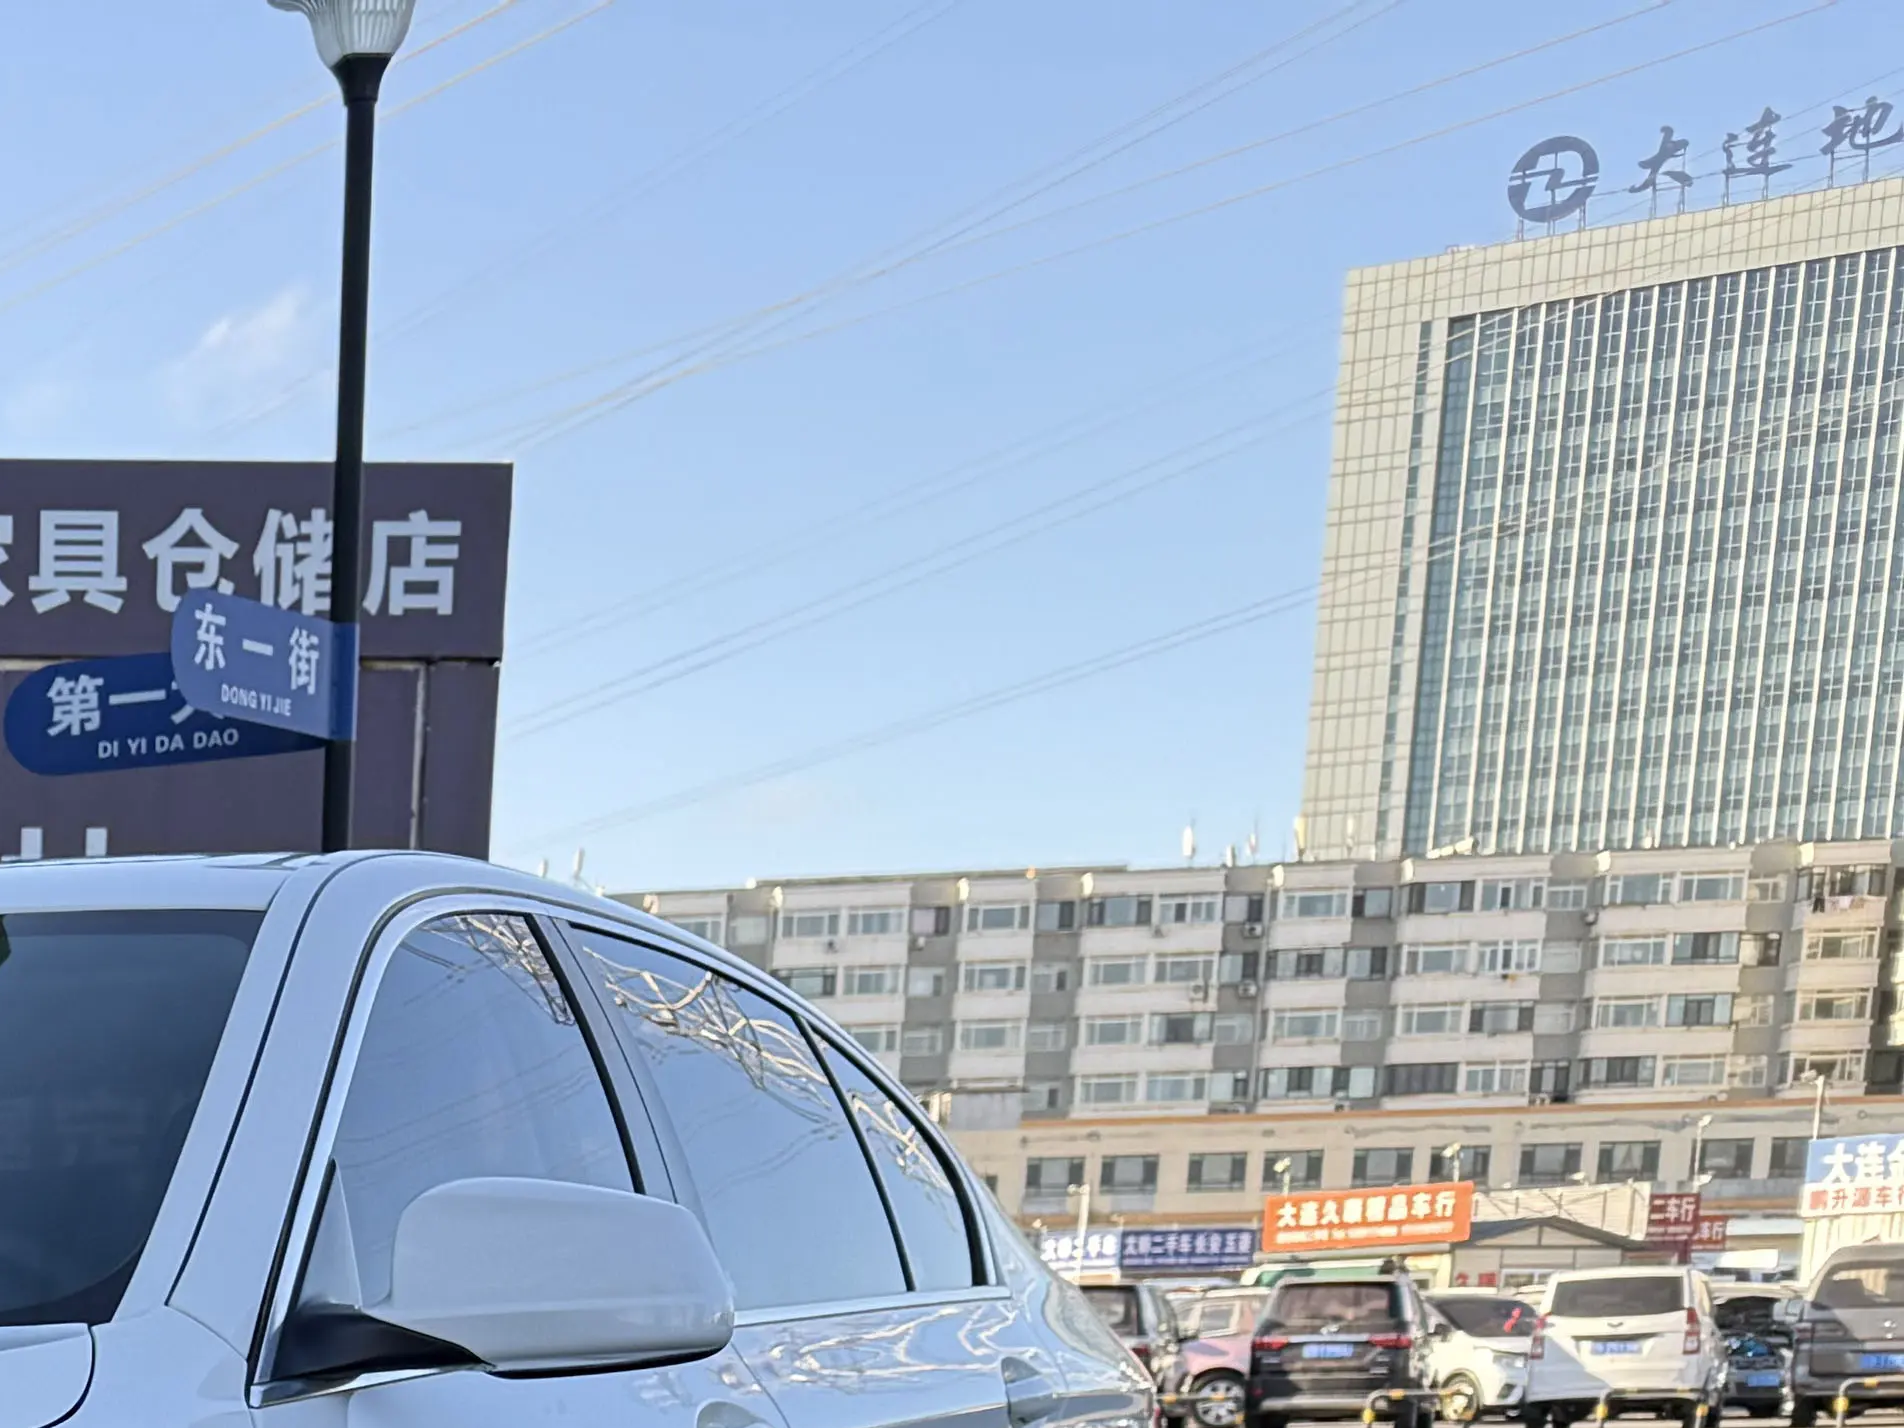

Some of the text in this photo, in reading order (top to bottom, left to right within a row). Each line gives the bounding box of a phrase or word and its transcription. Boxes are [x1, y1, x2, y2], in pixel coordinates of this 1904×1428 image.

[194, 603, 319, 695] 东一街
[220, 683, 257, 708] DONG
[97, 727, 240, 760] DI YI DA DAO
